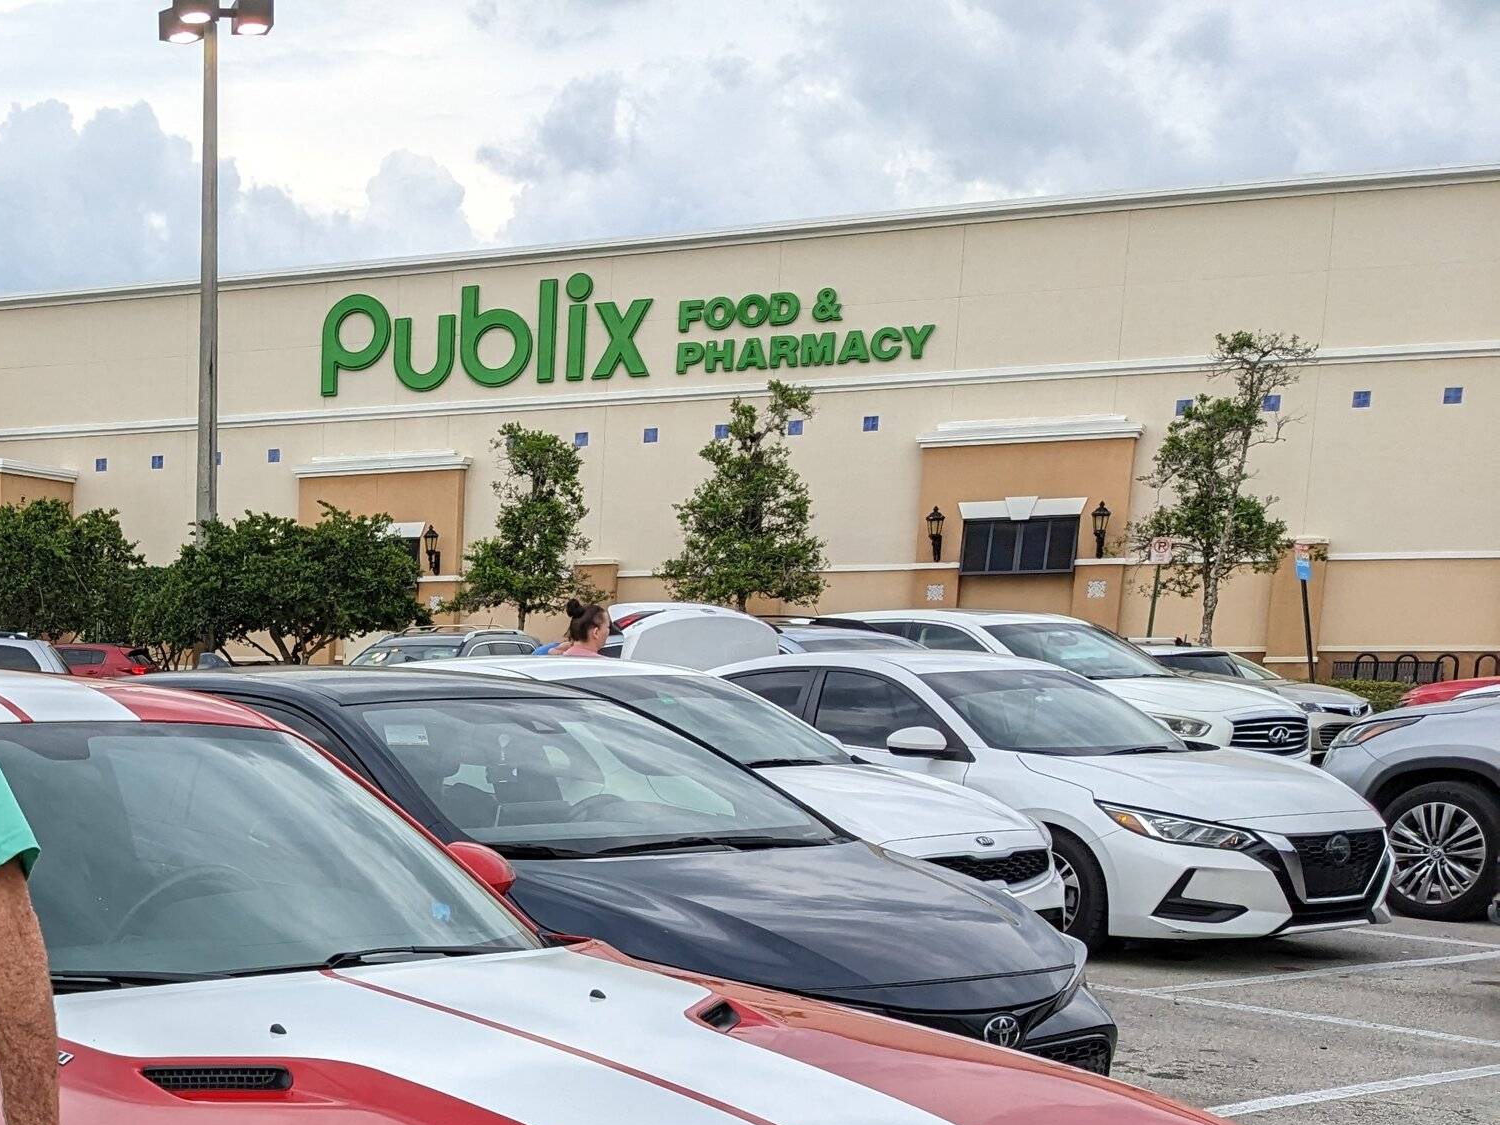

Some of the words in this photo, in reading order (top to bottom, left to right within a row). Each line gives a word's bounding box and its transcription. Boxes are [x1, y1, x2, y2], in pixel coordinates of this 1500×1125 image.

[321, 272, 653, 397] Publix
[678, 292, 800, 332] FOOD
[812, 287, 842, 322] &
[676, 324, 935, 375] PHARMACY
